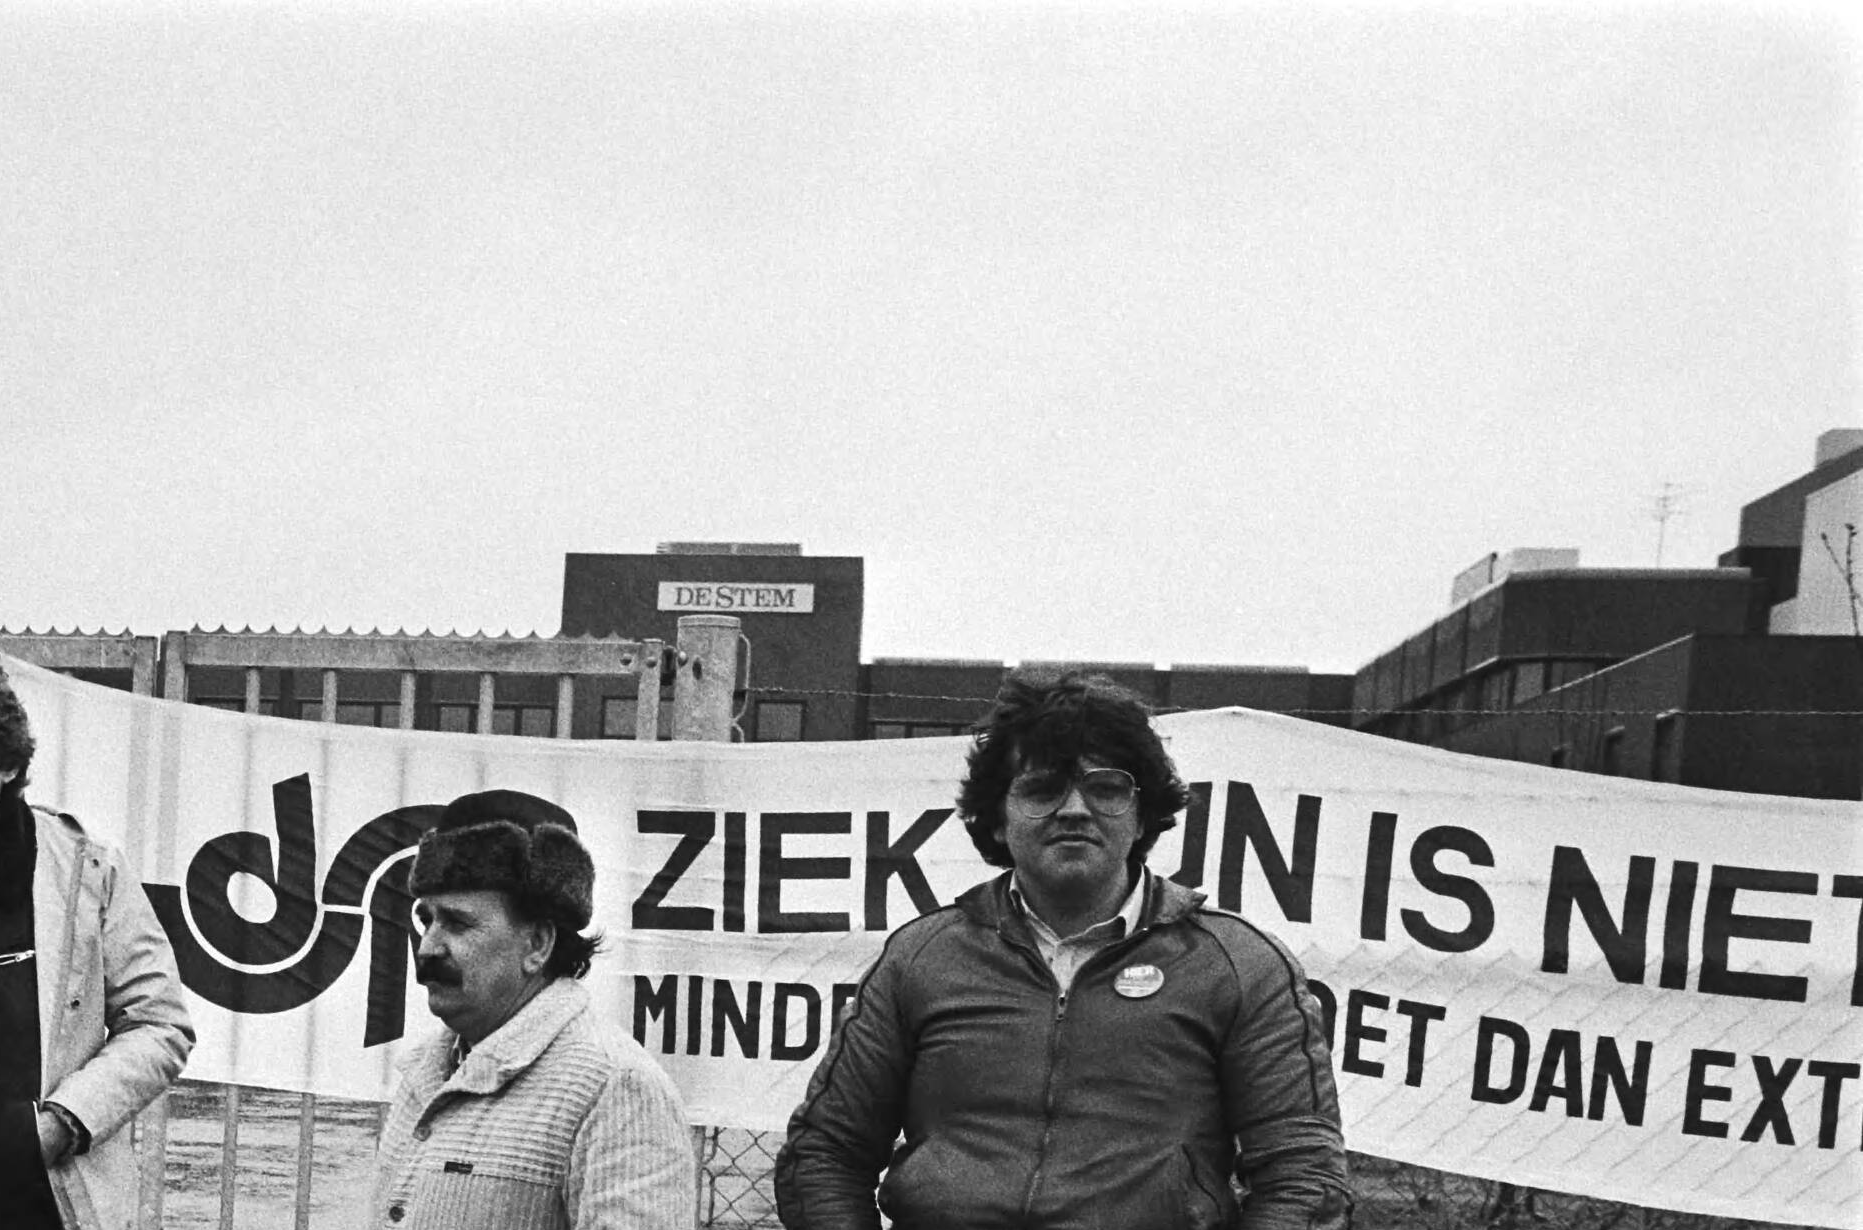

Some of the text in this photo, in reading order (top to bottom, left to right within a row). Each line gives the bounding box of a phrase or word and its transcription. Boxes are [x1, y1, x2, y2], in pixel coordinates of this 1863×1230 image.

[631, 807, 956, 934] ZIEK
[1168, 780, 1323, 924] JN
[1360, 811, 1495, 953] IS
[1470, 1015, 1653, 1127] DAN
[1681, 1048, 1863, 1151] EXT
